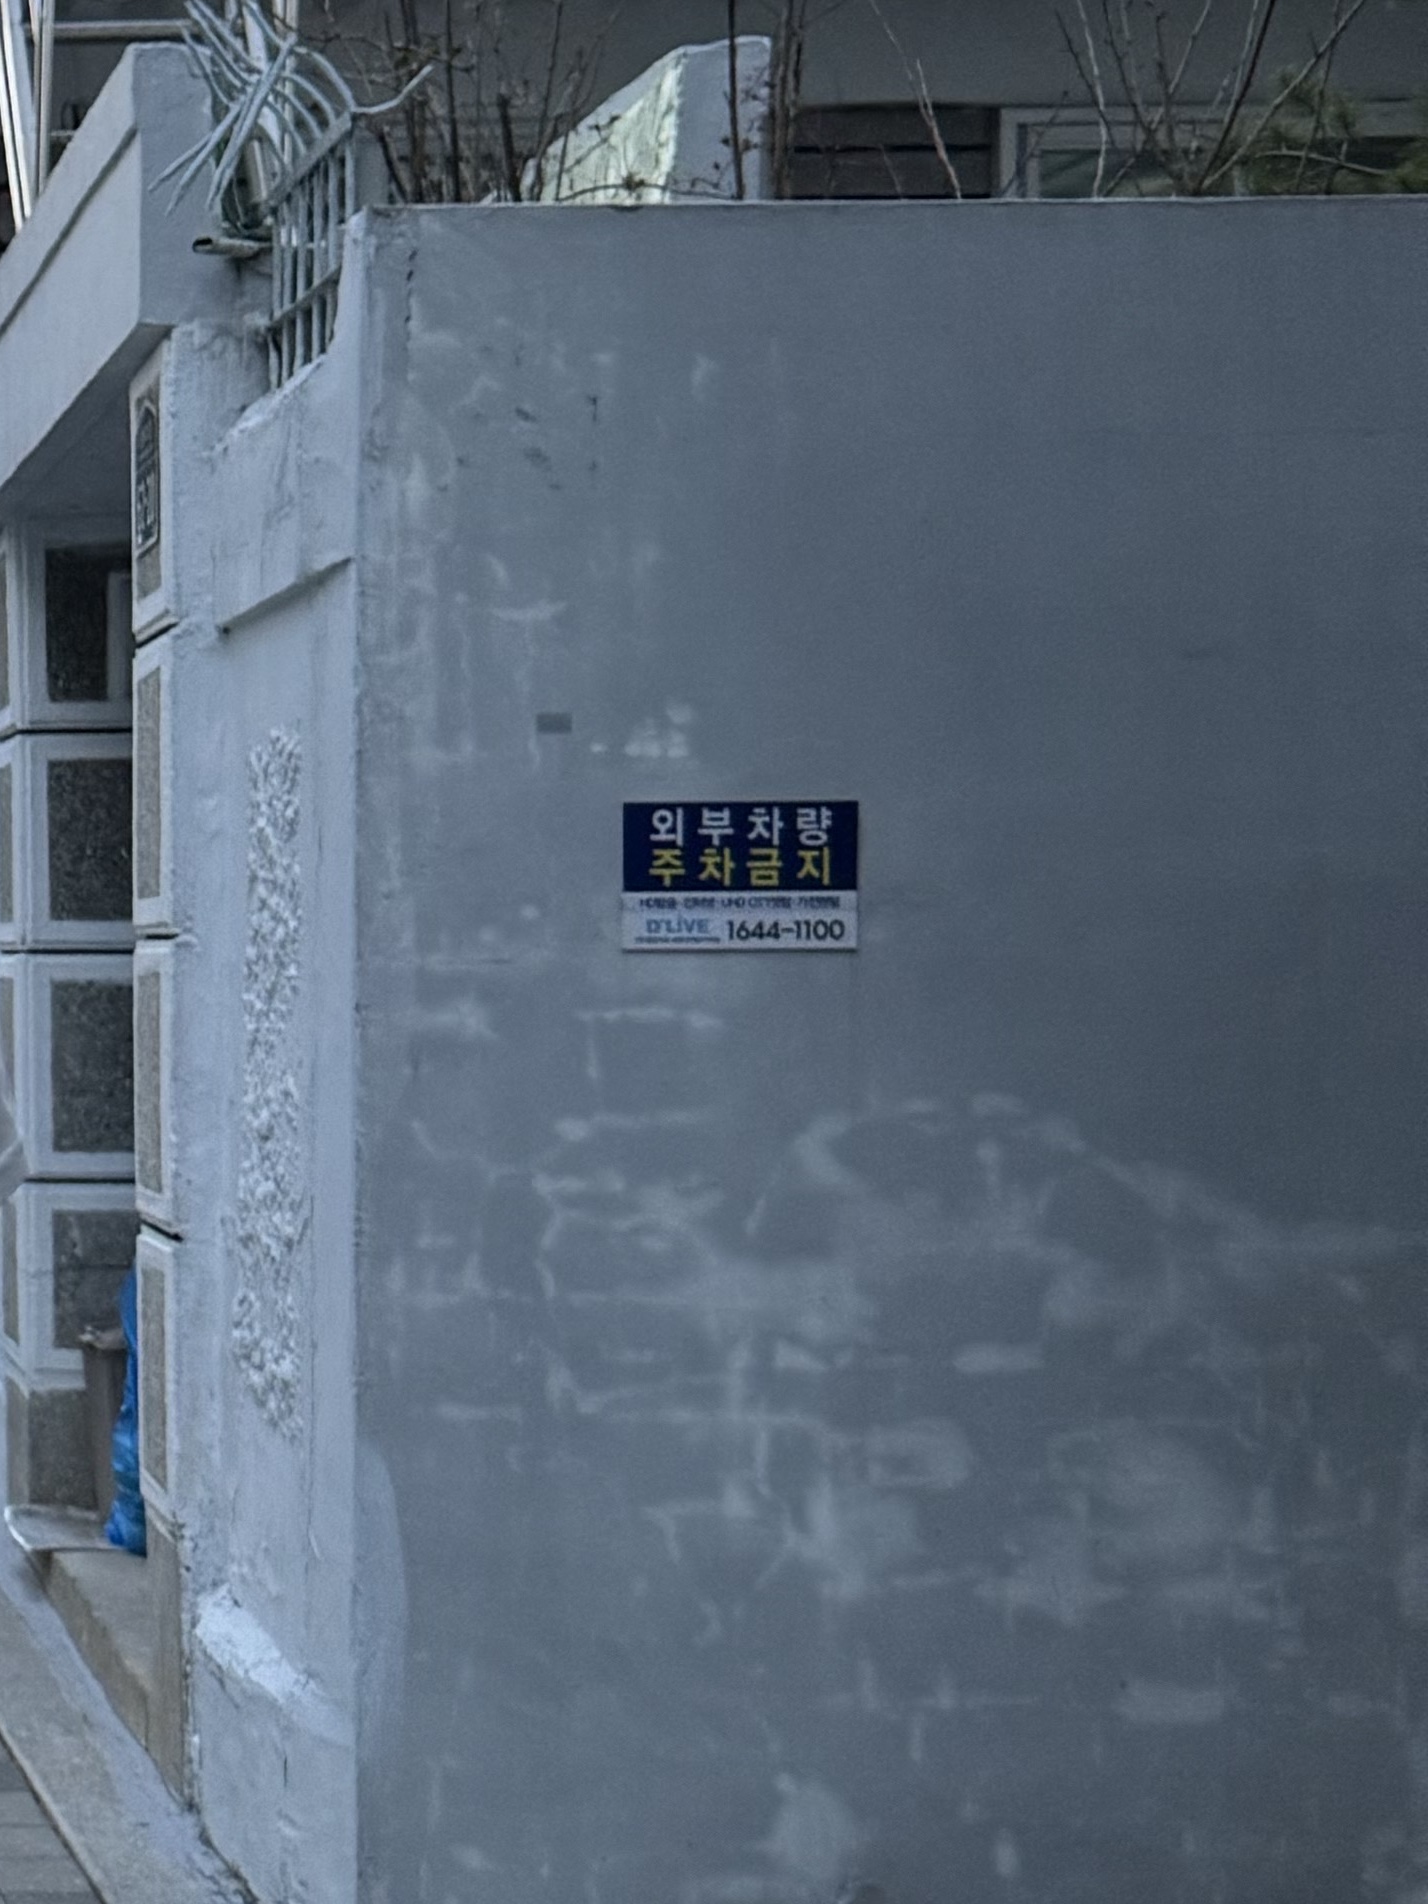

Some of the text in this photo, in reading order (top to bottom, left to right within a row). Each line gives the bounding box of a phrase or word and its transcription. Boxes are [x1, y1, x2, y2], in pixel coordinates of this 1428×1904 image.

[649, 806, 833, 847] 외부차량
[648, 846, 831, 887] 주차금지
[727, 918, 845, 941] 1644-1100
